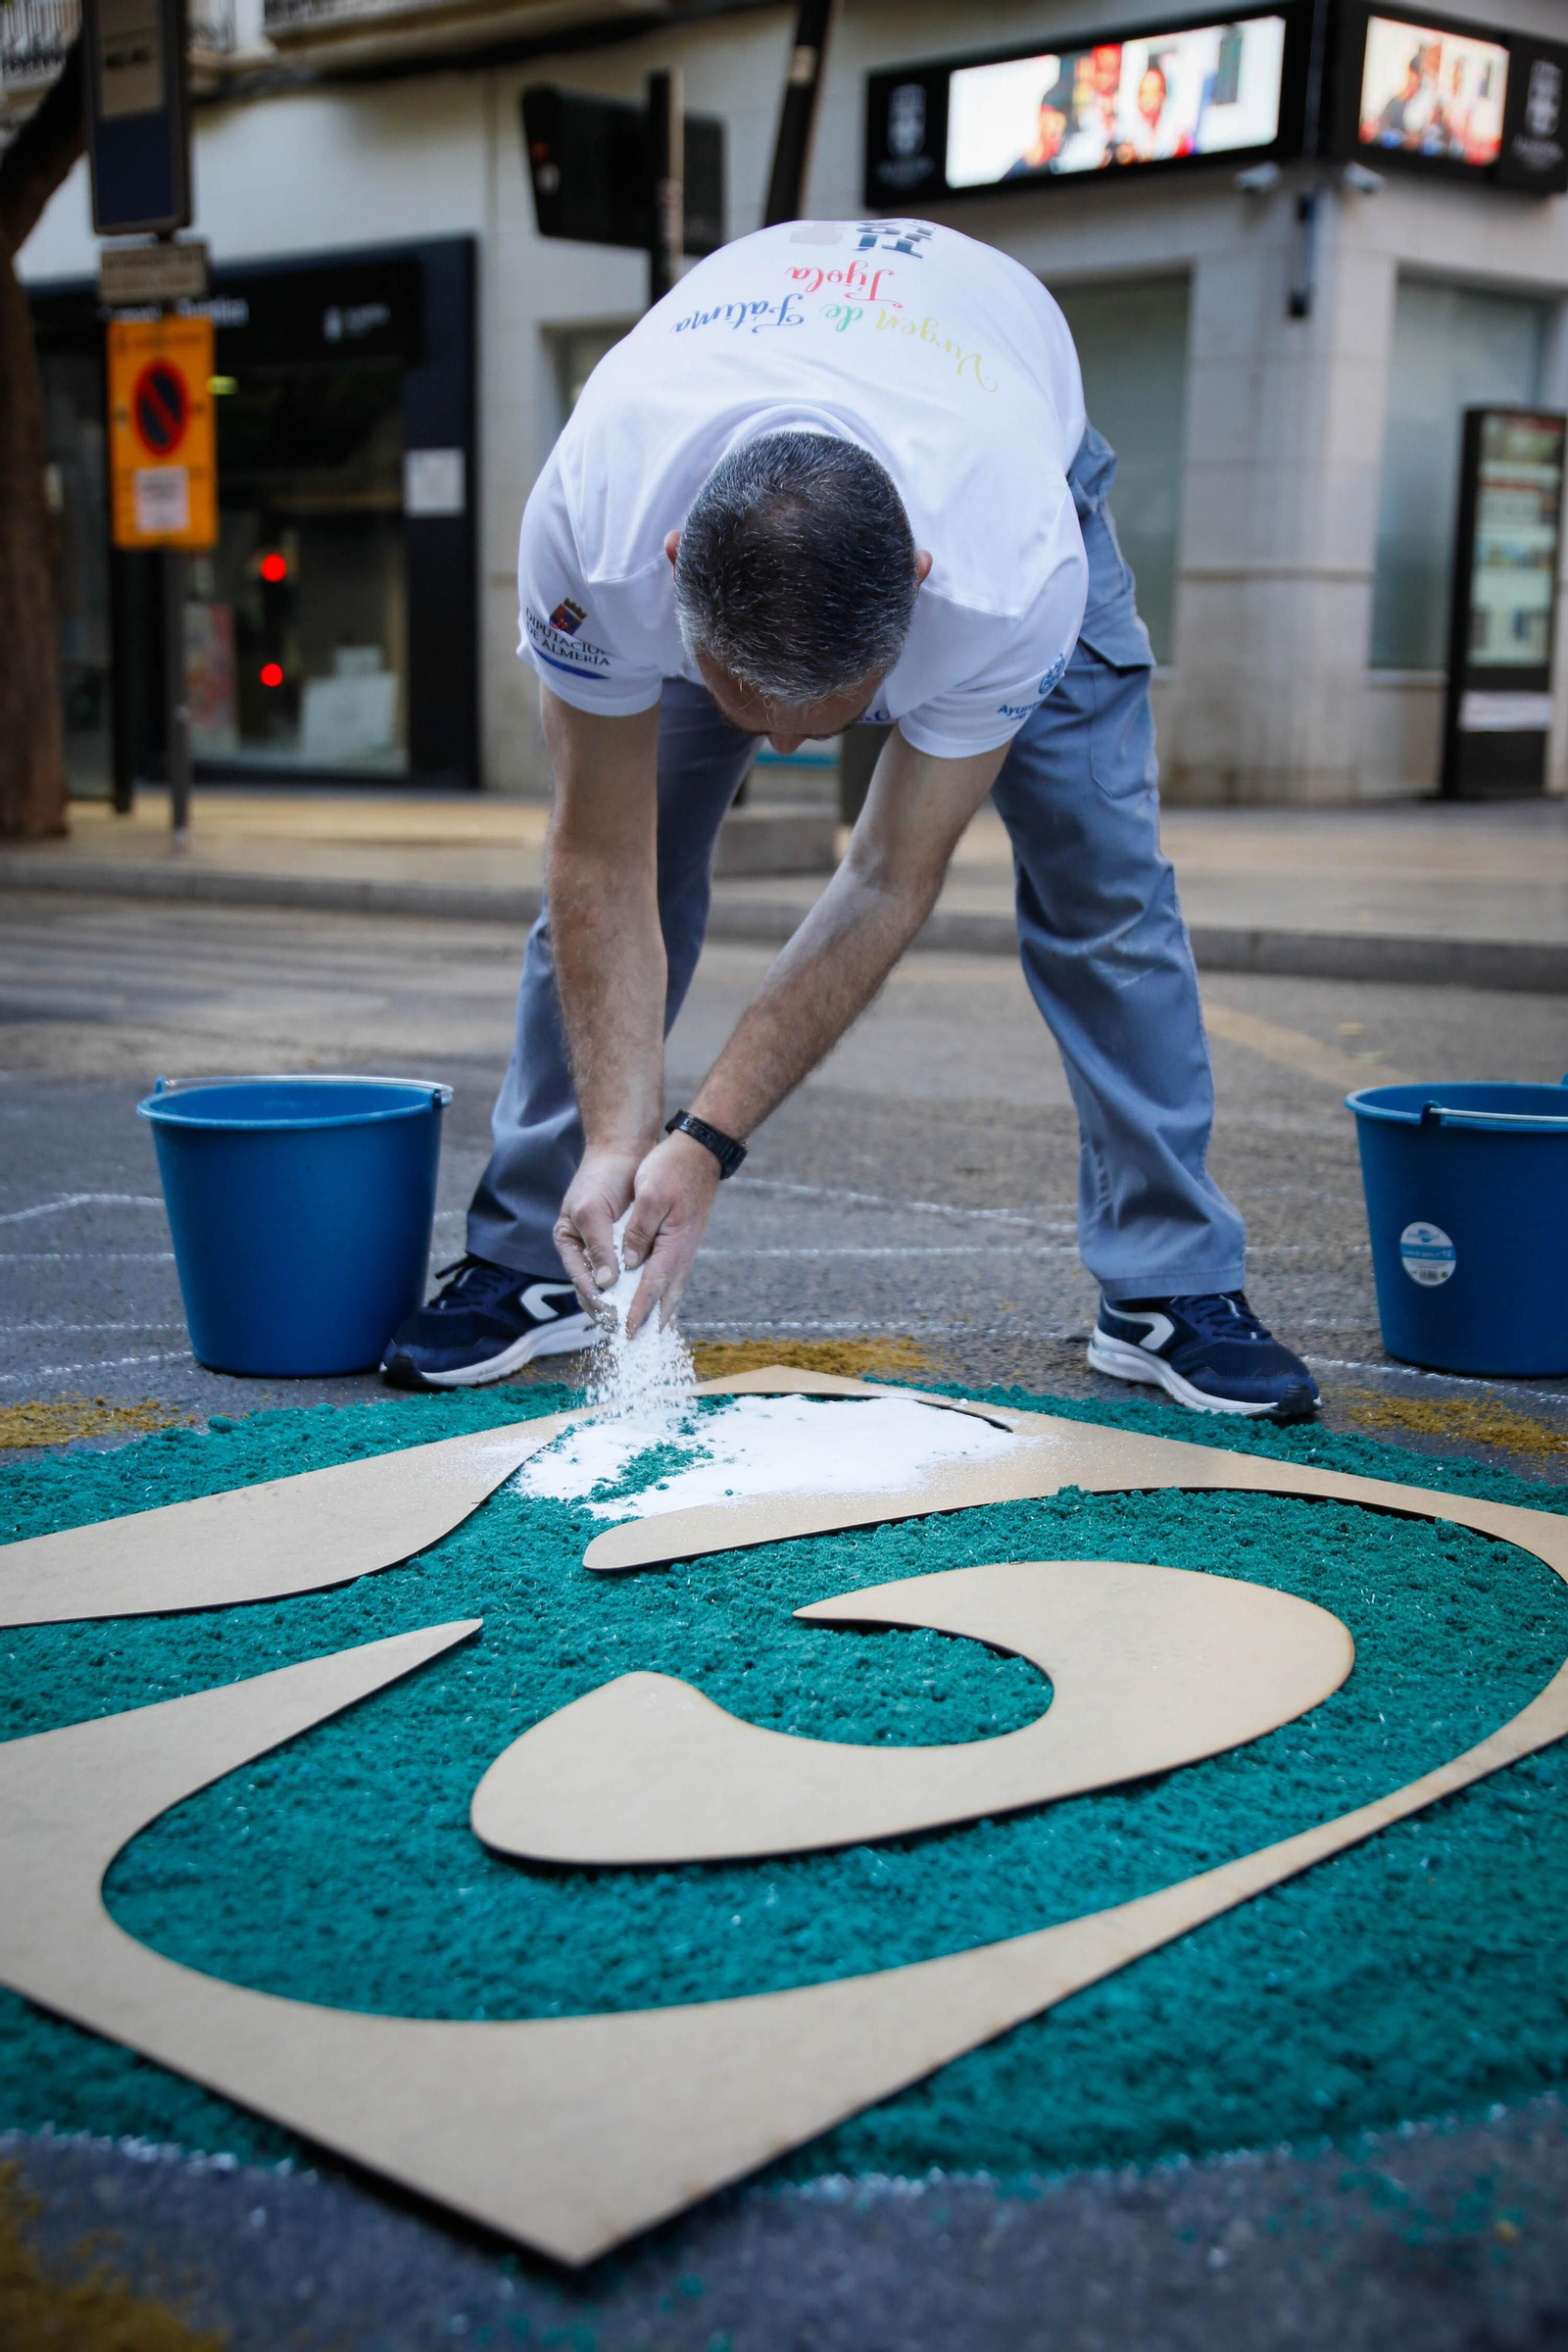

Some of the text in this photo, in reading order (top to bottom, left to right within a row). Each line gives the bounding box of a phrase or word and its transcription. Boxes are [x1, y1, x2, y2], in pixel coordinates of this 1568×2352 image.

[785, 260, 904, 309] Tíjola
[669, 293, 999, 392] Virgen de Fátima
[542, 639, 611, 665] ALMERÍA
